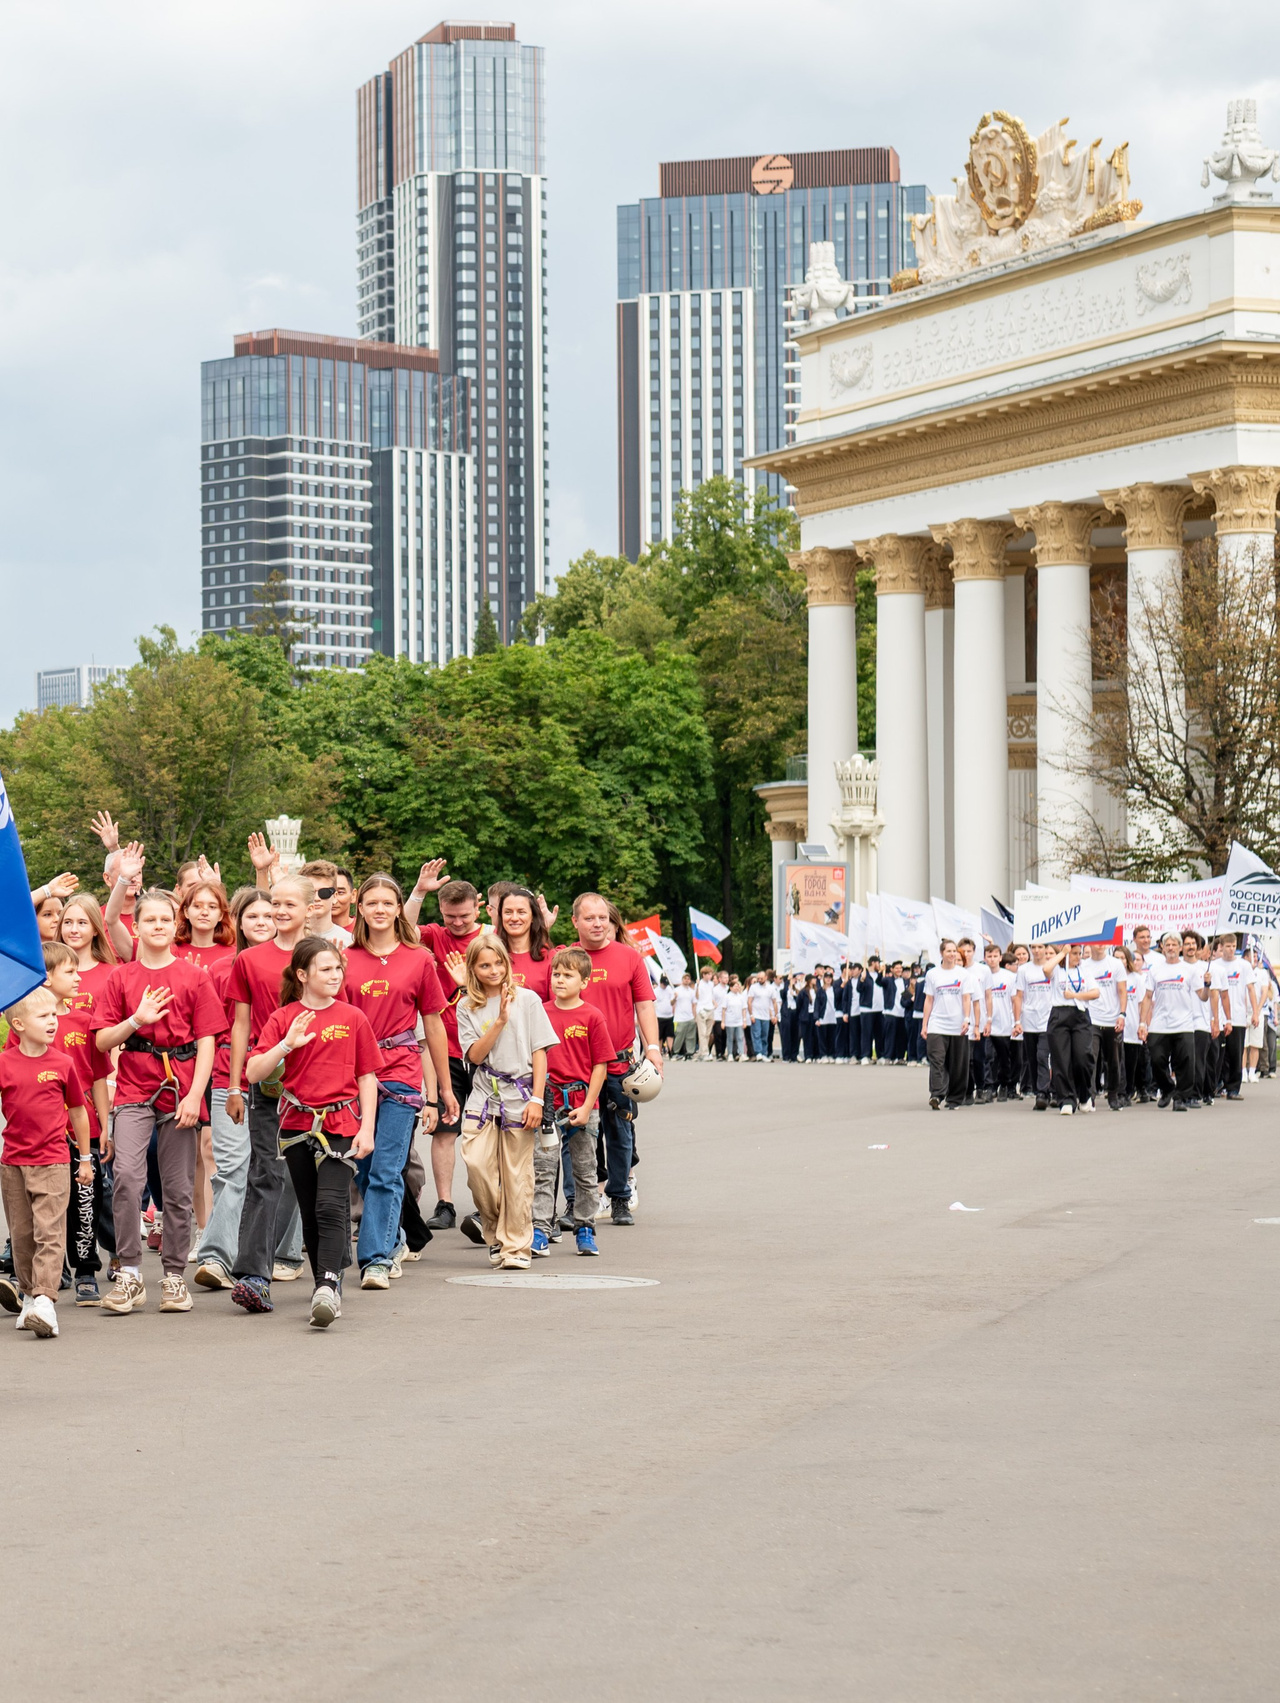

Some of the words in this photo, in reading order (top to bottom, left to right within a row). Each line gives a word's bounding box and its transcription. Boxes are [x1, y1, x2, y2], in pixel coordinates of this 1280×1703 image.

[804, 879, 827, 890] ГОРОД
[1152, 887, 1223, 901] ФИЗКУЛЬТПАРА
[1170, 902, 1188, 911] ШАГ
[1192, 898, 1221, 910] НАЗАД
[1031, 904, 1081, 941] ПАРКУР
[1168, 911, 1192, 921] ВНИЗ
